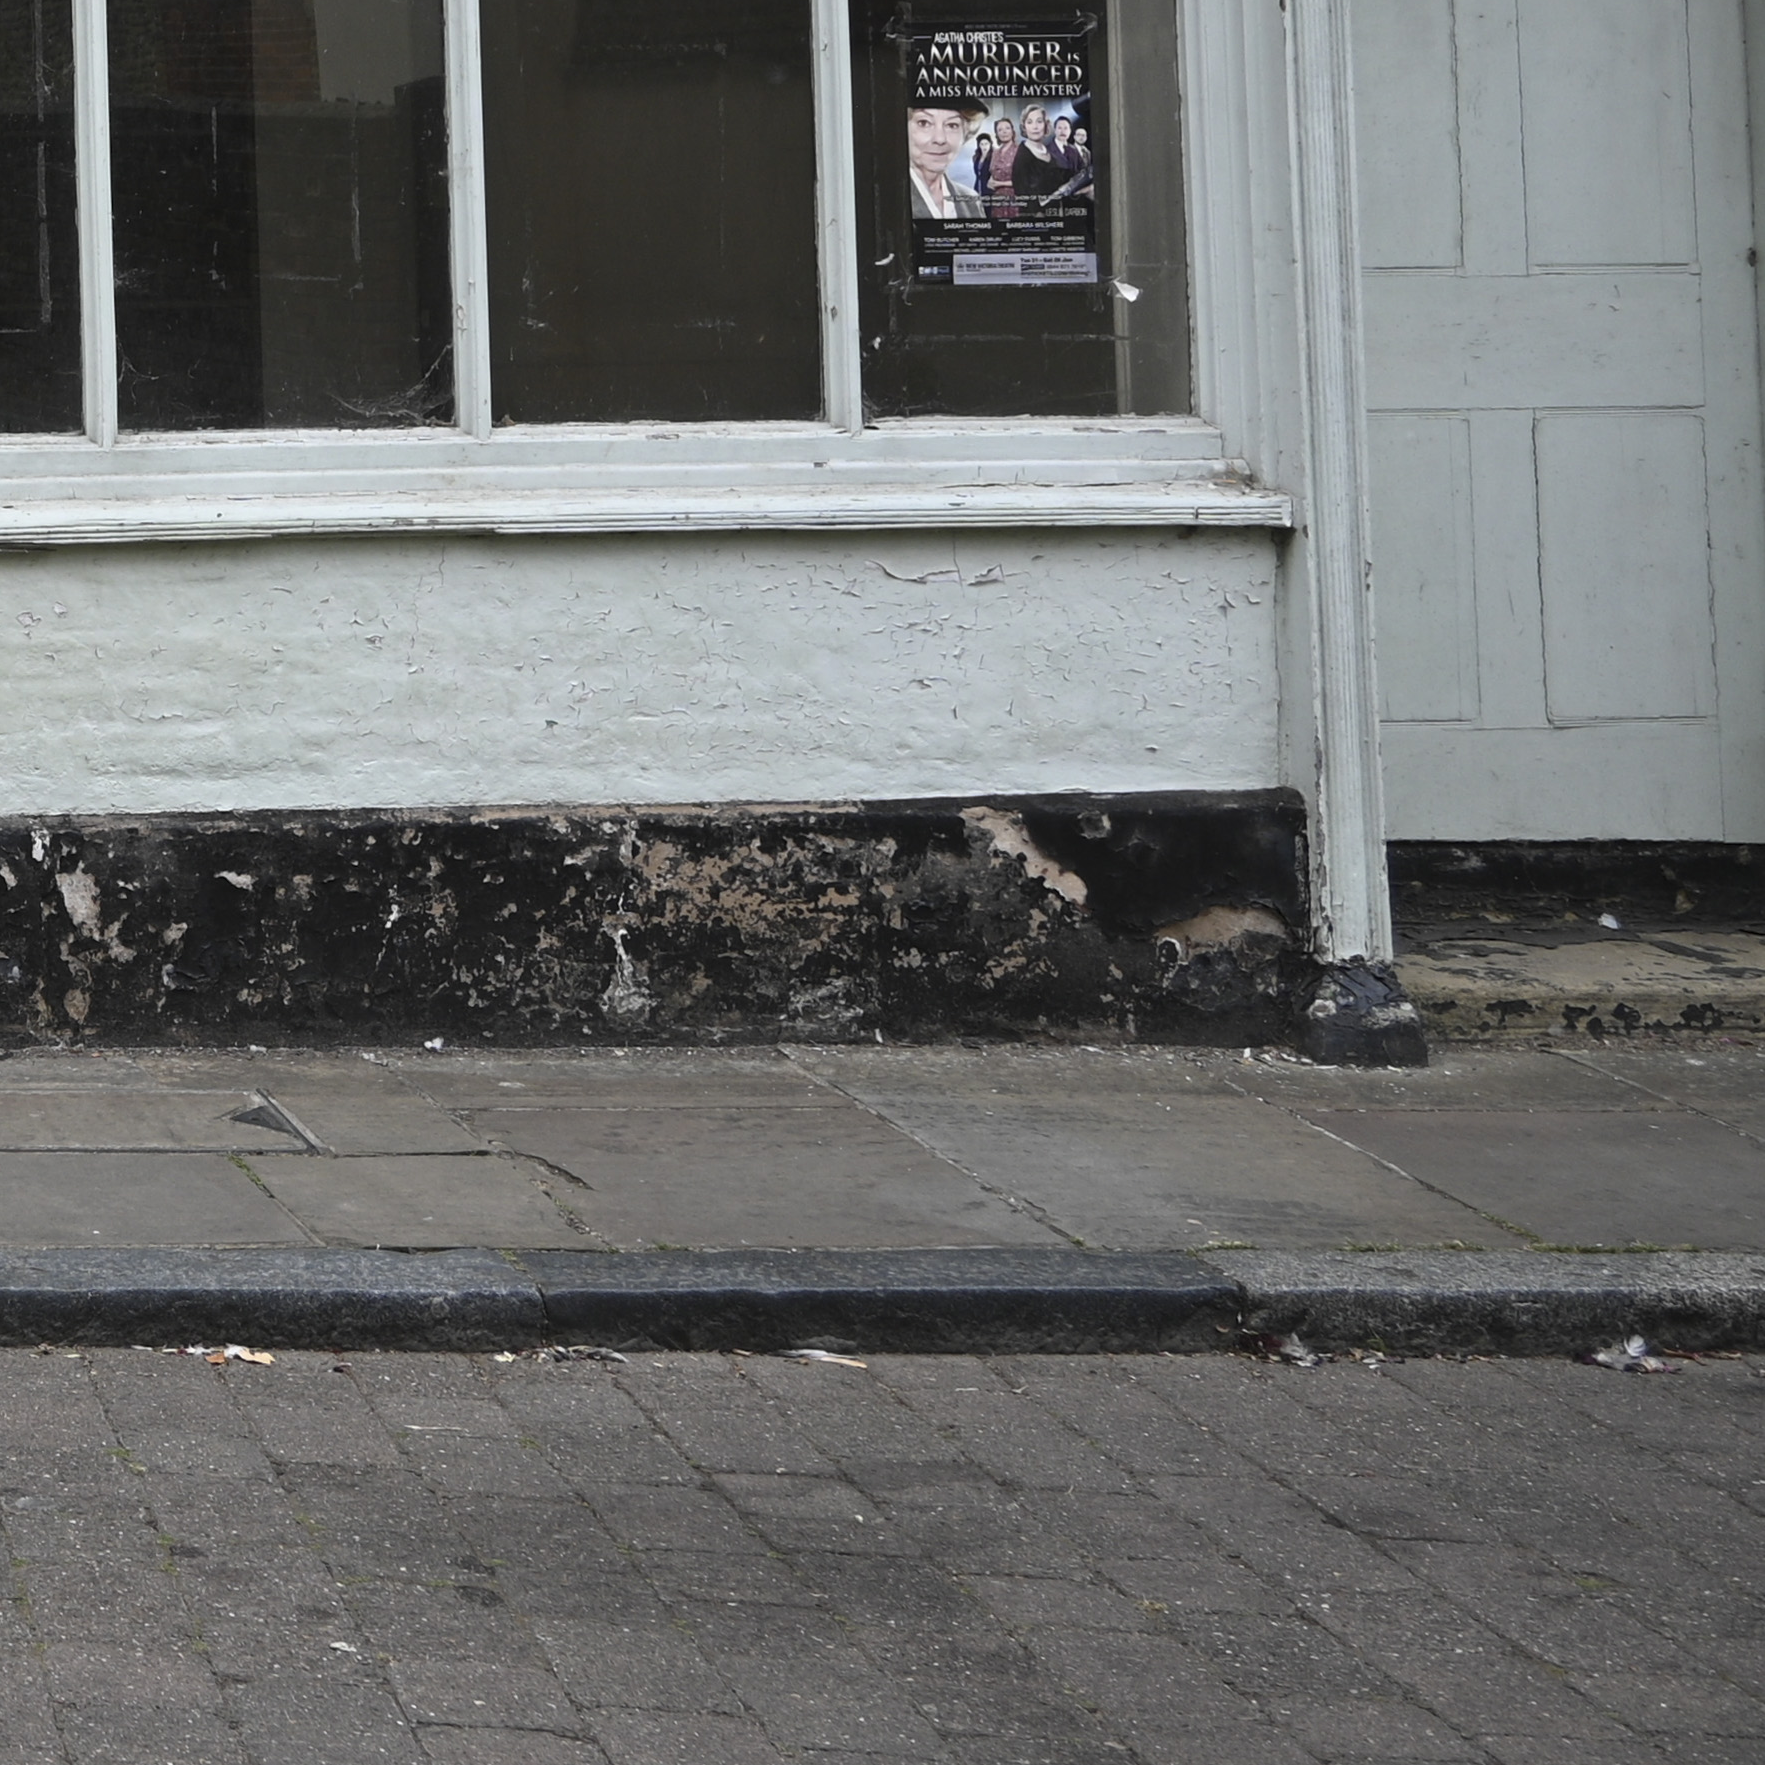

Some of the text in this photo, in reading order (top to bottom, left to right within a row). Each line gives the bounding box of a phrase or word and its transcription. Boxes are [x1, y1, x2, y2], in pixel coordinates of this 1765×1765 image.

[933, 32, 965, 44] AGATHA
[915, 41, 1080, 66] A MURDER IS
[916, 64, 1083, 85] ANNOUNCED
[915, 83, 1083, 98] A MISS MARPLE MYSTERY
